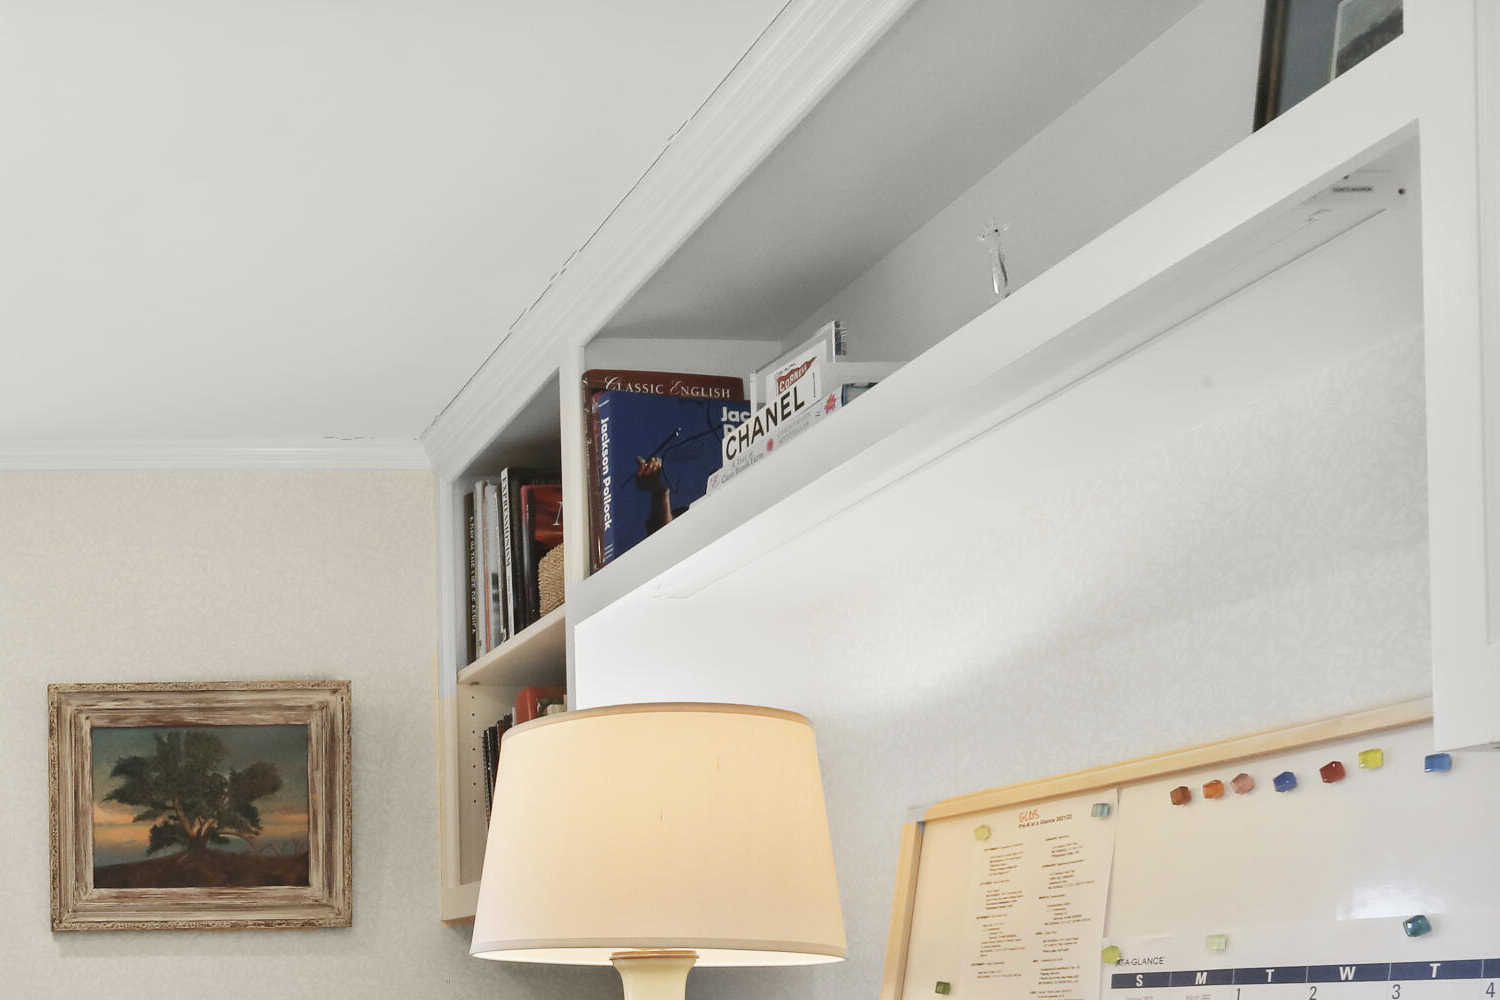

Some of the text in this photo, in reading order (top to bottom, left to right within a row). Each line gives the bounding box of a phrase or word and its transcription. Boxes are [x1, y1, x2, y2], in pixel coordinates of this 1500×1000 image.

[604, 376, 731, 399] CLASSIC ENGLISH
[780, 364, 808, 392] CORNELL
[726, 387, 804, 461] CHANEL
[600, 417, 614, 532] Jackson Pollock
[501, 477, 512, 568] EXPRESSIONISM
[1136, 963, 1441, 987] S M T W T
[1308, 986, 1318, 1000] 2
[1391, 984, 1401, 1000] 3
[1485, 982, 1496, 998] 4
